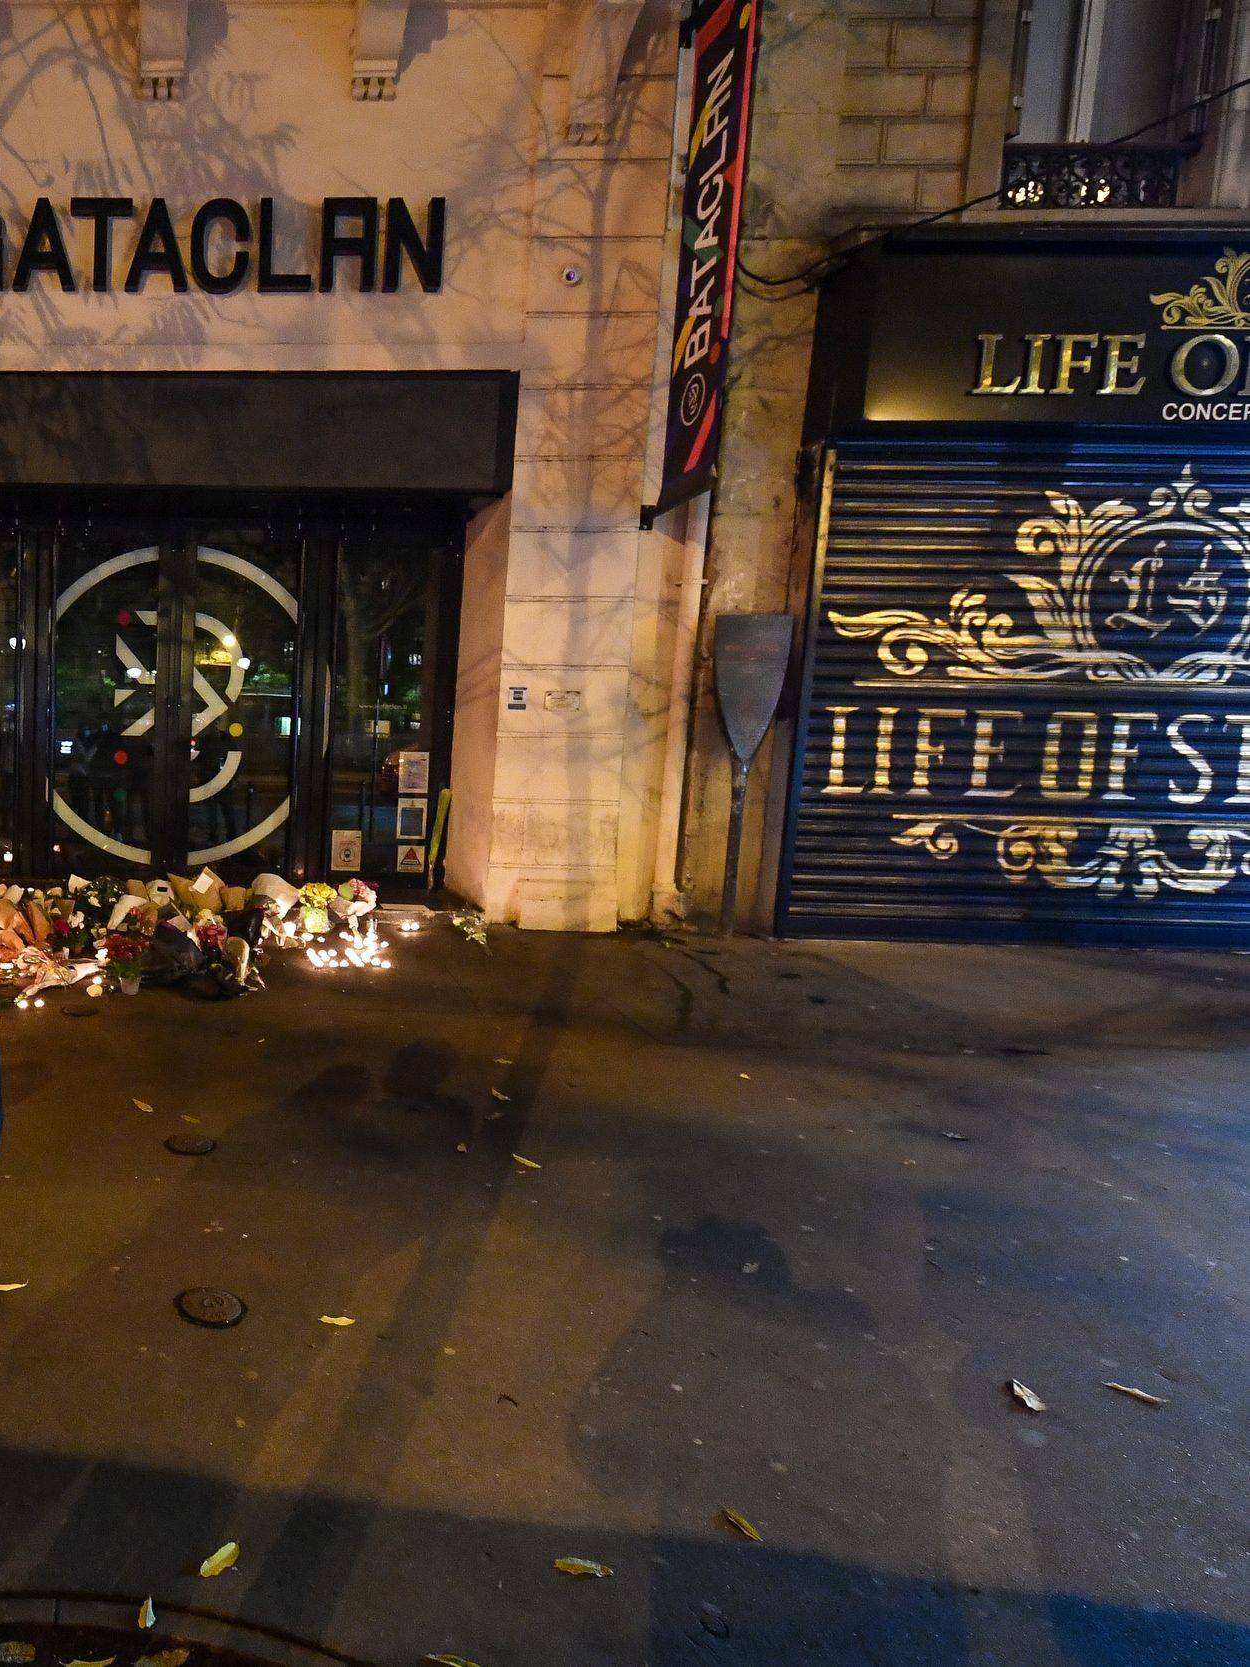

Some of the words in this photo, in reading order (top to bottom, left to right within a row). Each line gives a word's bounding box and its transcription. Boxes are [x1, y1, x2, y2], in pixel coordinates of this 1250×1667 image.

[683, 48, 735, 370] BATACLAN
[971, 333, 1146, 395] LIFE
[820, 706, 1024, 798] LIFE
